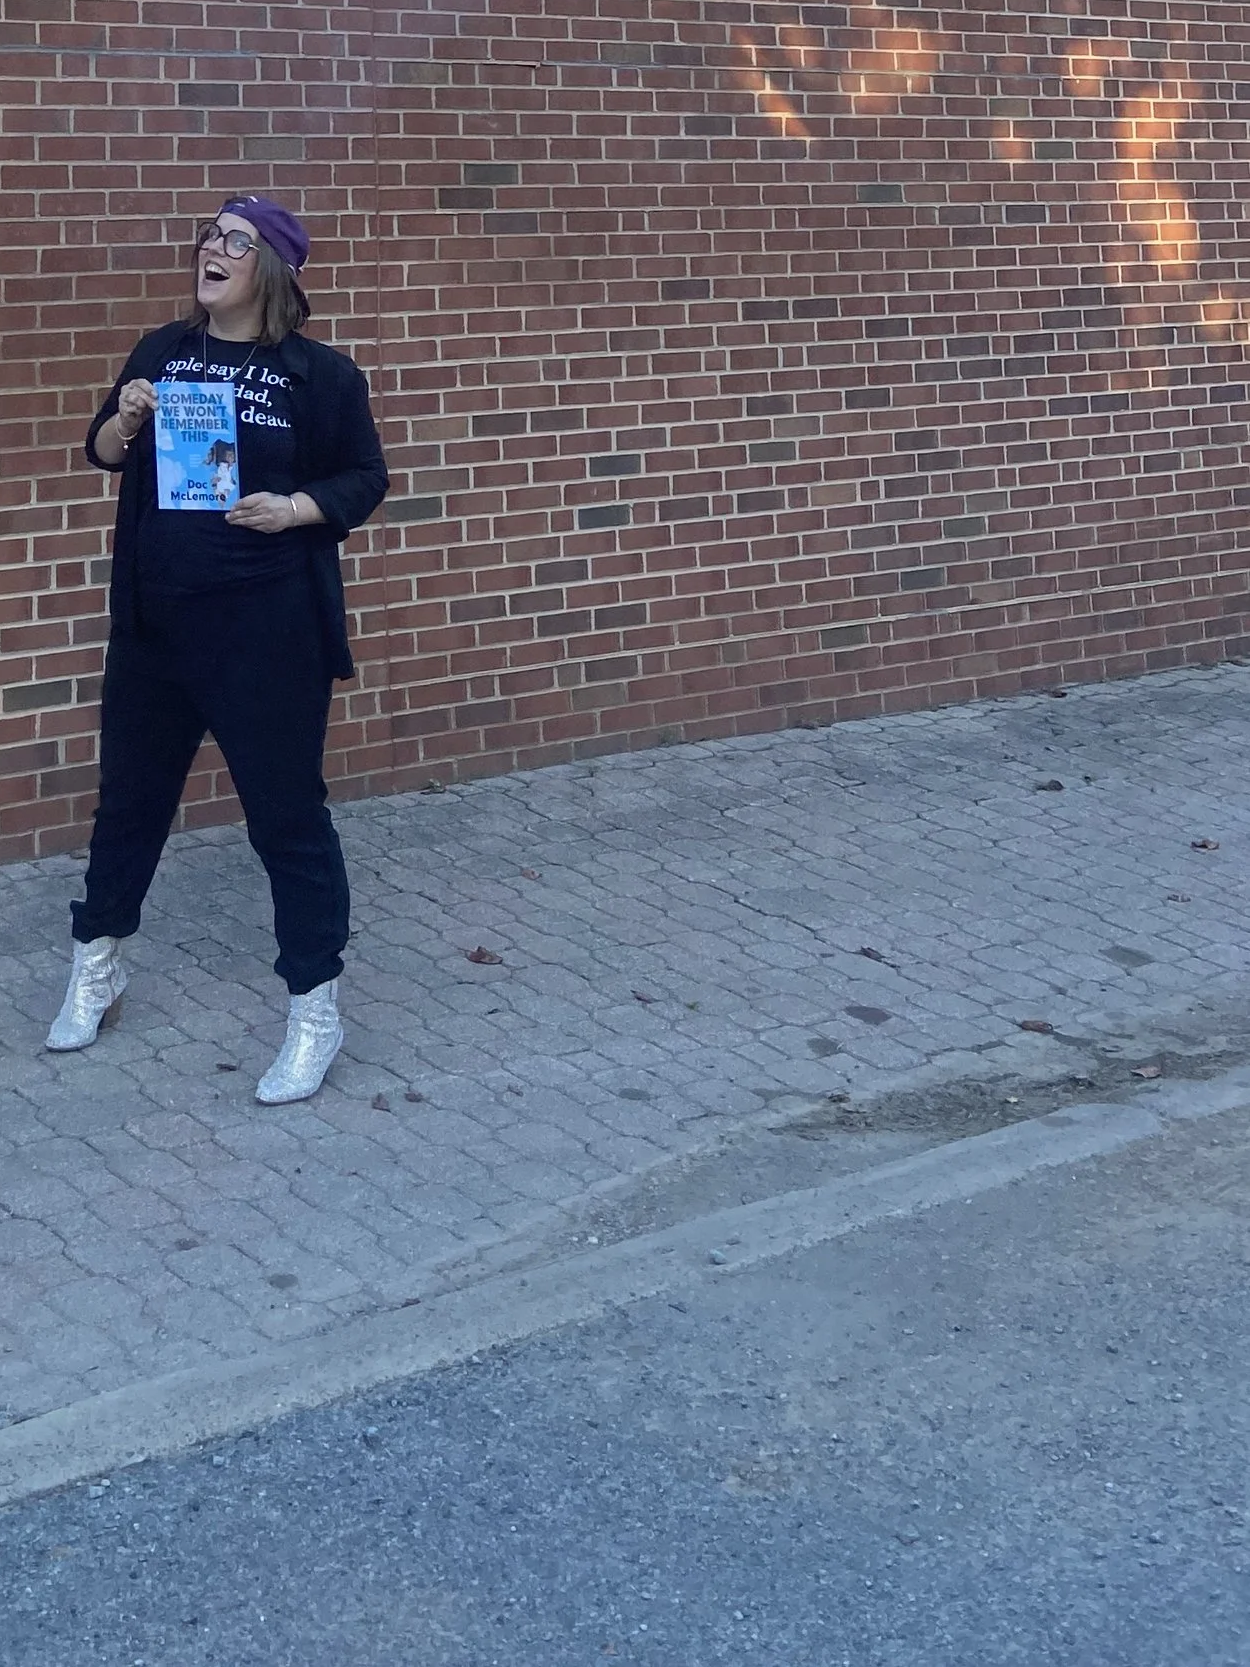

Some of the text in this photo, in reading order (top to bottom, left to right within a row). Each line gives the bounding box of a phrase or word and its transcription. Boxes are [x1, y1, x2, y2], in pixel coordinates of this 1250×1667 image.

[164, 356, 204, 375] ople
[207, 363, 241, 381] say
[244, 365, 257, 381] I
[162, 393, 224, 405] SOMEDAY
[160, 405, 227, 417] WE WON'T
[160, 418, 229, 430] REMEMBER
[180, 430, 209, 443] THIS
[187, 479, 208, 490] Doc
[170, 491, 227, 502] McLemore
